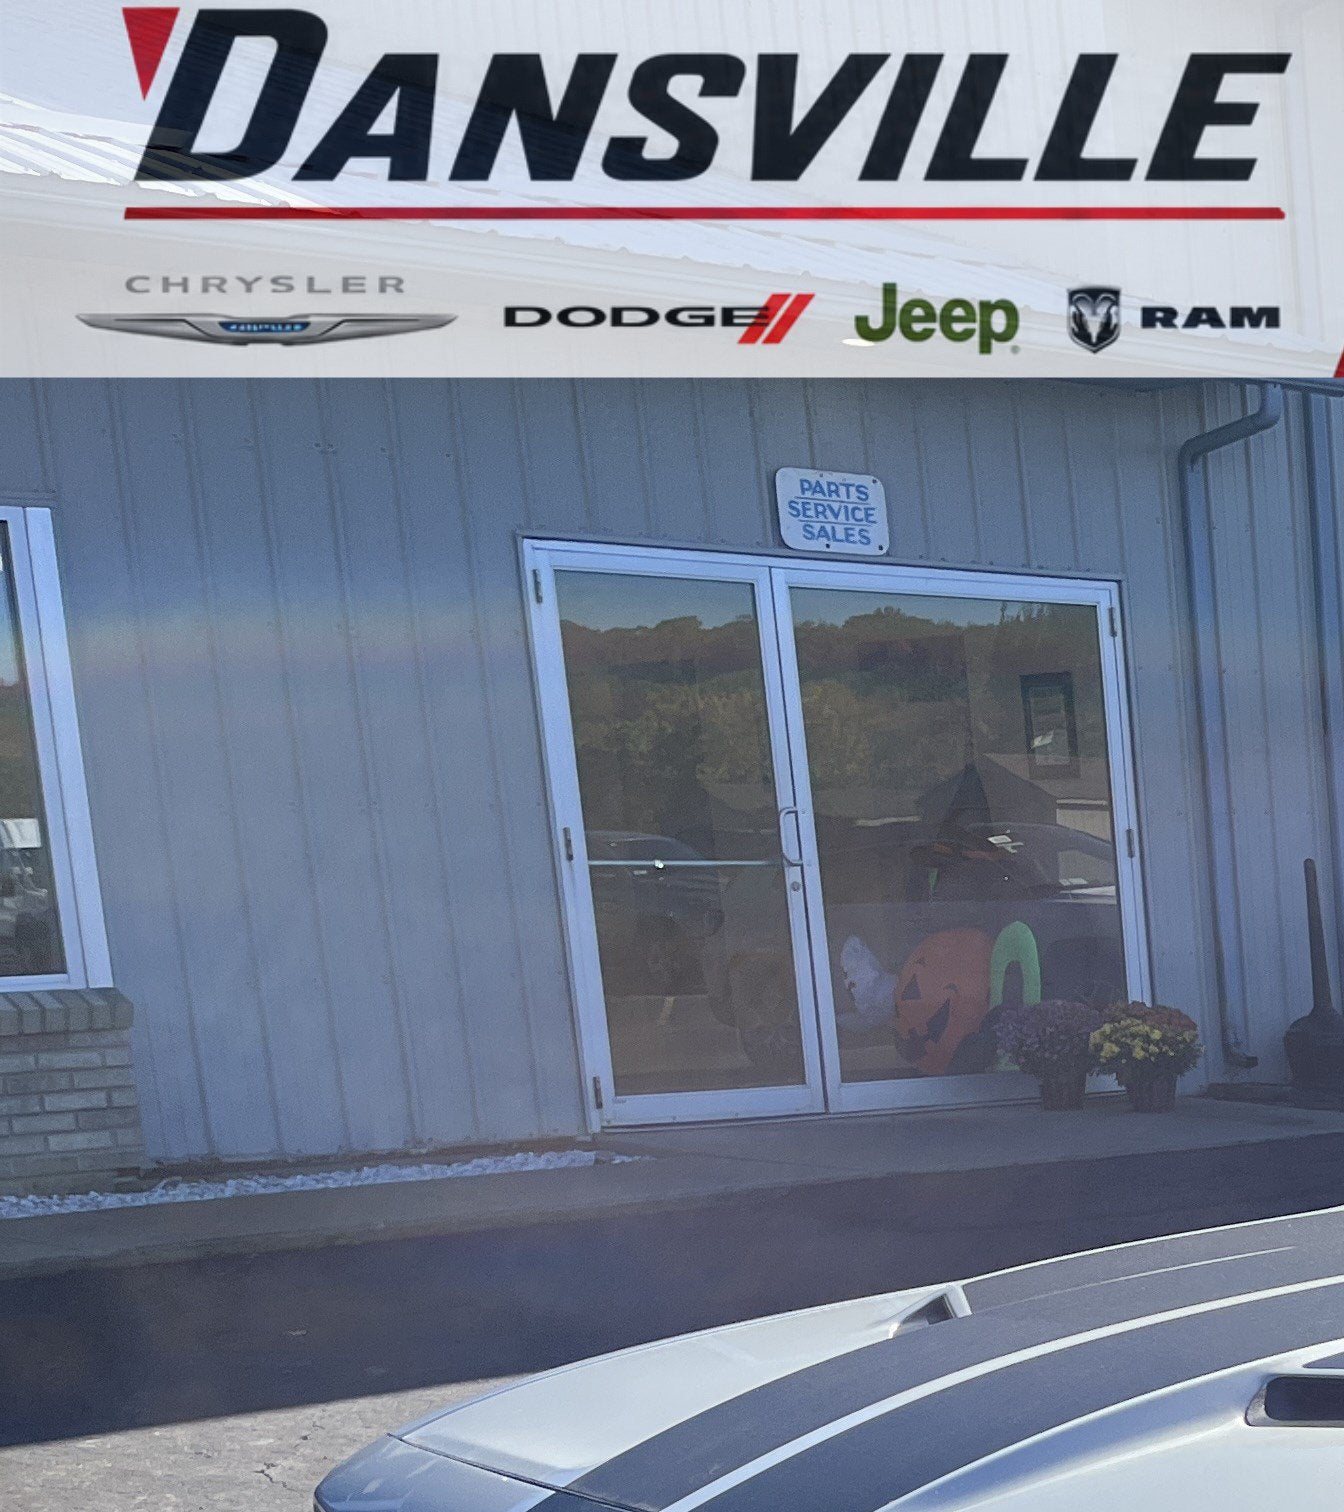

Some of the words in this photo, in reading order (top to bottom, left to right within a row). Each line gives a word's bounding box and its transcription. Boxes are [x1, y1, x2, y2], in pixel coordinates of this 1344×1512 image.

[800, 478, 869, 502] PARTS
[788, 500, 877, 524] SERVICE
[802, 524, 871, 546] SALES
